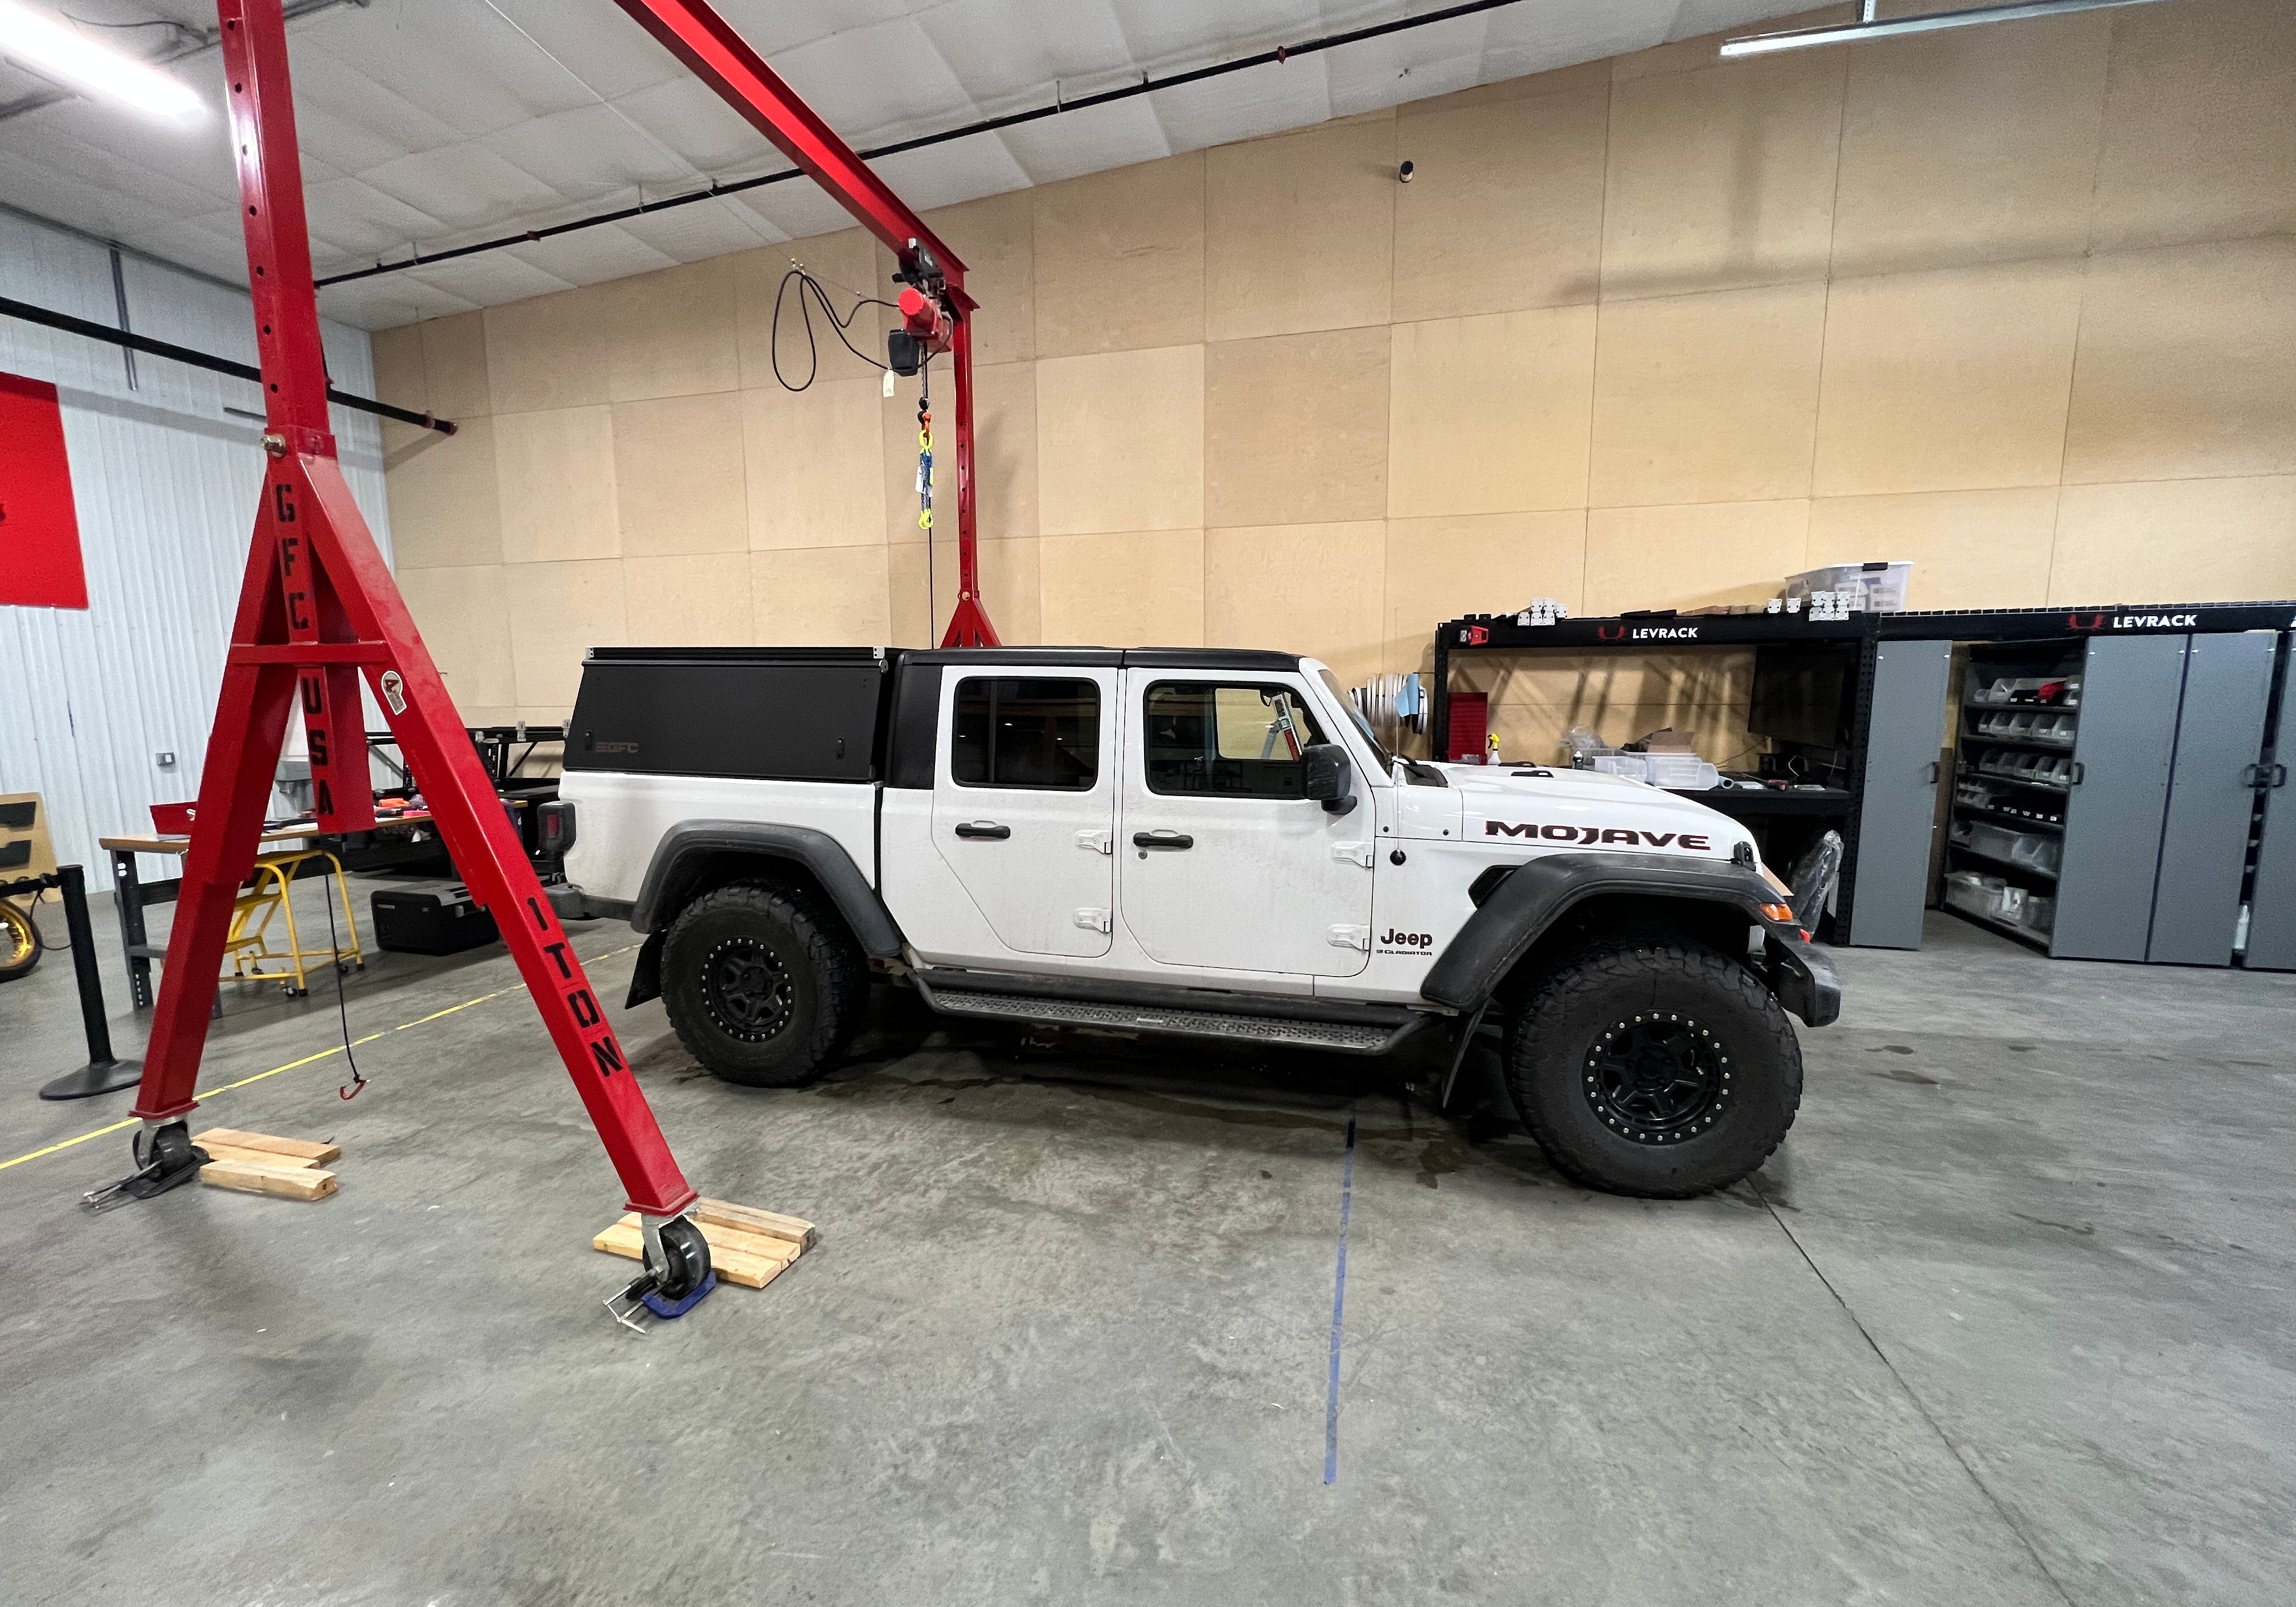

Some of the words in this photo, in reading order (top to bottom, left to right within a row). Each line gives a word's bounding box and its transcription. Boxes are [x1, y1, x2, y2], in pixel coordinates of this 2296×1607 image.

[1633, 627, 1698, 639] LEVRACK
[2113, 614, 2197, 628] LEVRACK
[276, 484, 309, 630] GFC
[302, 677, 334, 815] USA
[1486, 821, 1711, 851] MOJAVE
[1380, 928, 1433, 949] Jeep
[543, 942, 624, 1077] TON
